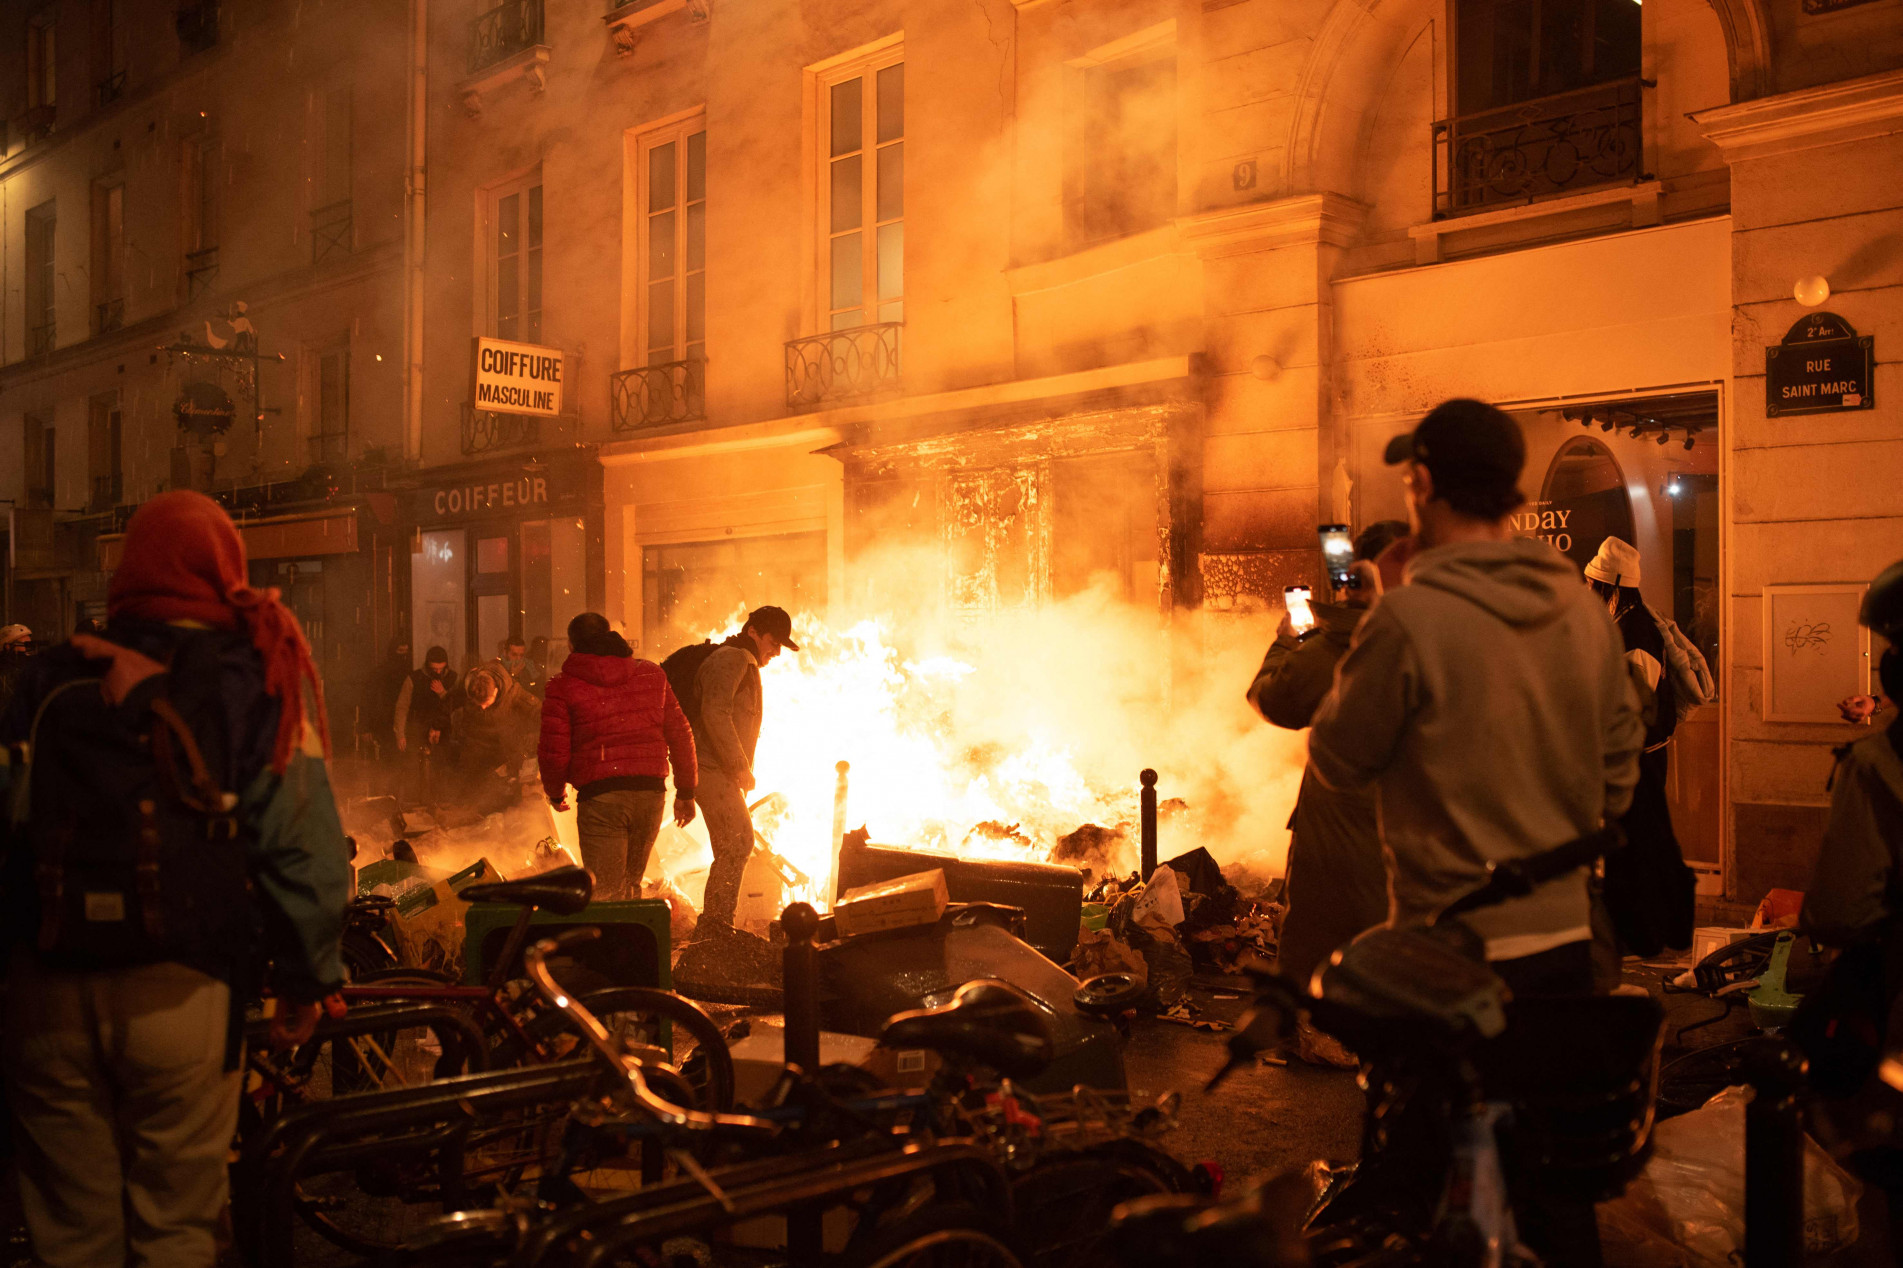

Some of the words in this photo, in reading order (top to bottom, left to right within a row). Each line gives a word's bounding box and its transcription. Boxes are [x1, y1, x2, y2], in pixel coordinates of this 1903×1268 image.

[1238, 163, 1251, 187] 9
[481, 347, 562, 383] COIFFURE
[1806, 359, 1832, 373] RUE
[478, 383, 555, 411] MASCULINE
[1782, 383, 1817, 399] SAINT
[1820, 380, 1857, 395] MARC
[434, 477, 548, 515] COIFFEUR
